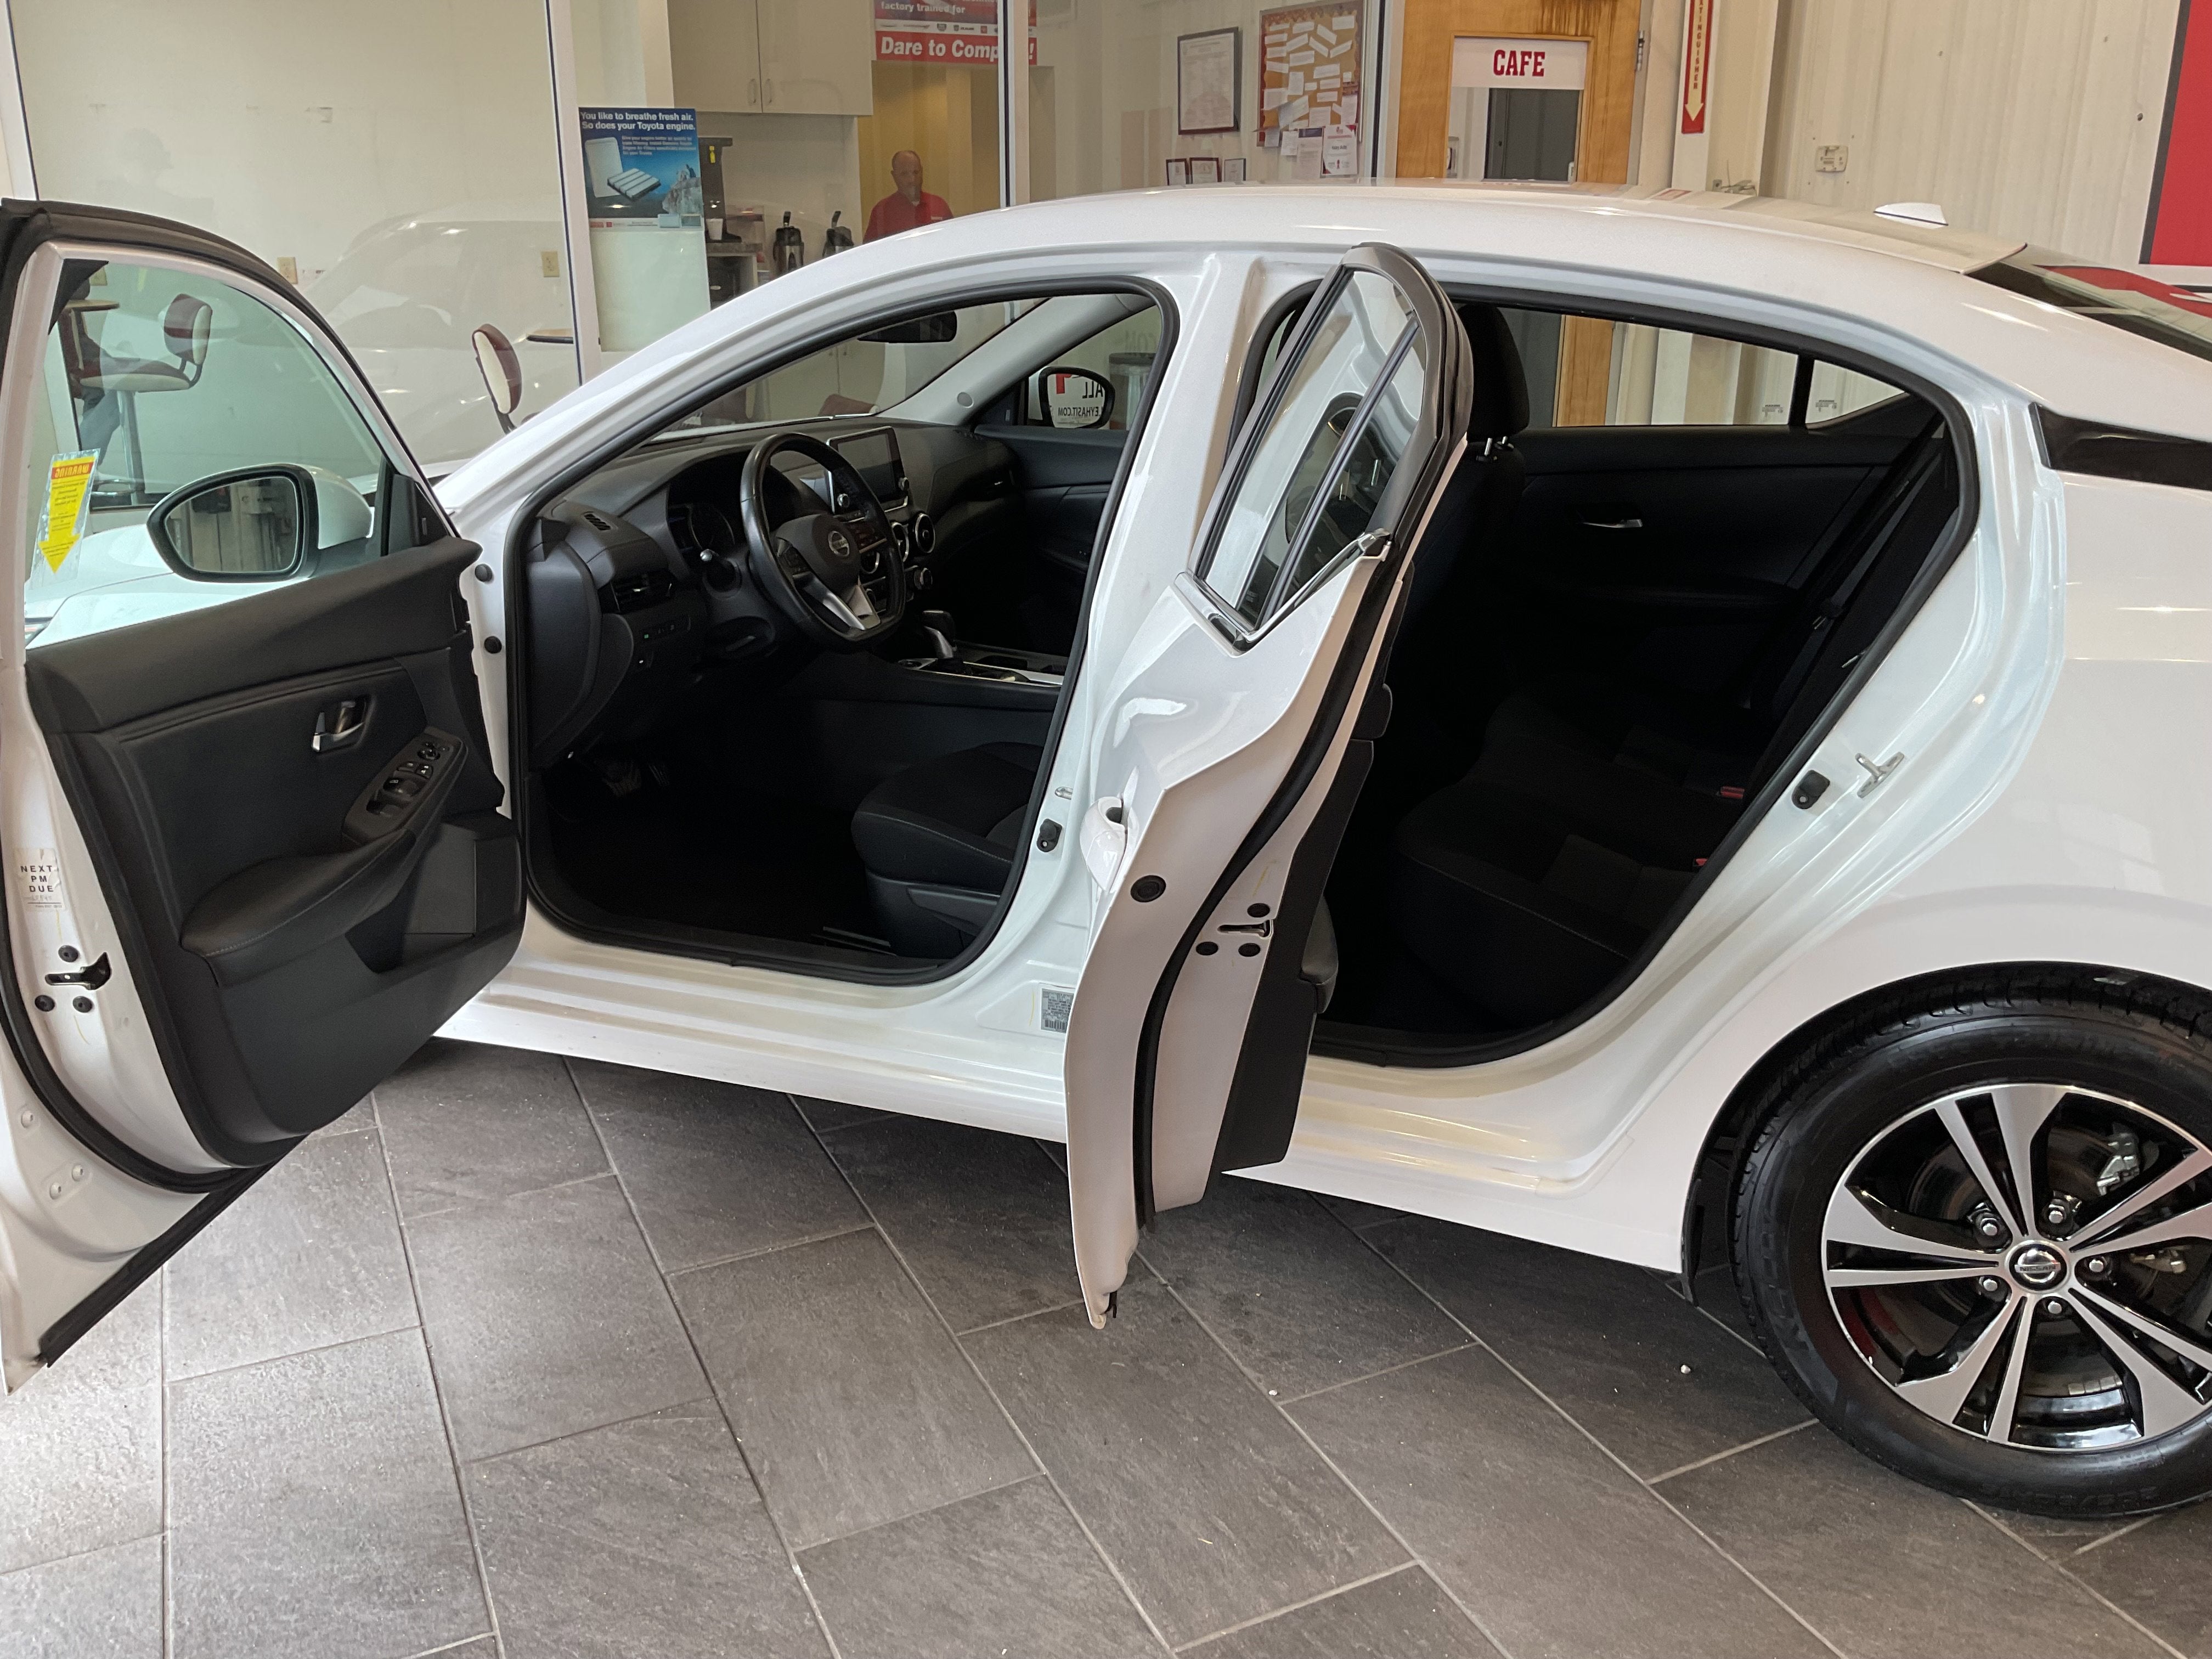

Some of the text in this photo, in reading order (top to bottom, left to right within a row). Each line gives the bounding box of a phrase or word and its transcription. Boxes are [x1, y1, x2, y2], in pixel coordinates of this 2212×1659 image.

[881, 2, 966, 15] factory trained for
[881, 37, 923, 55] Dare
[929, 40, 946, 56] to
[1493, 49, 1546, 77] CAFE
[625, 112, 657, 120] breathe
[617, 123, 636, 131] your
[636, 121, 664, 131] Toyota
[666, 122, 696, 132] engine.
